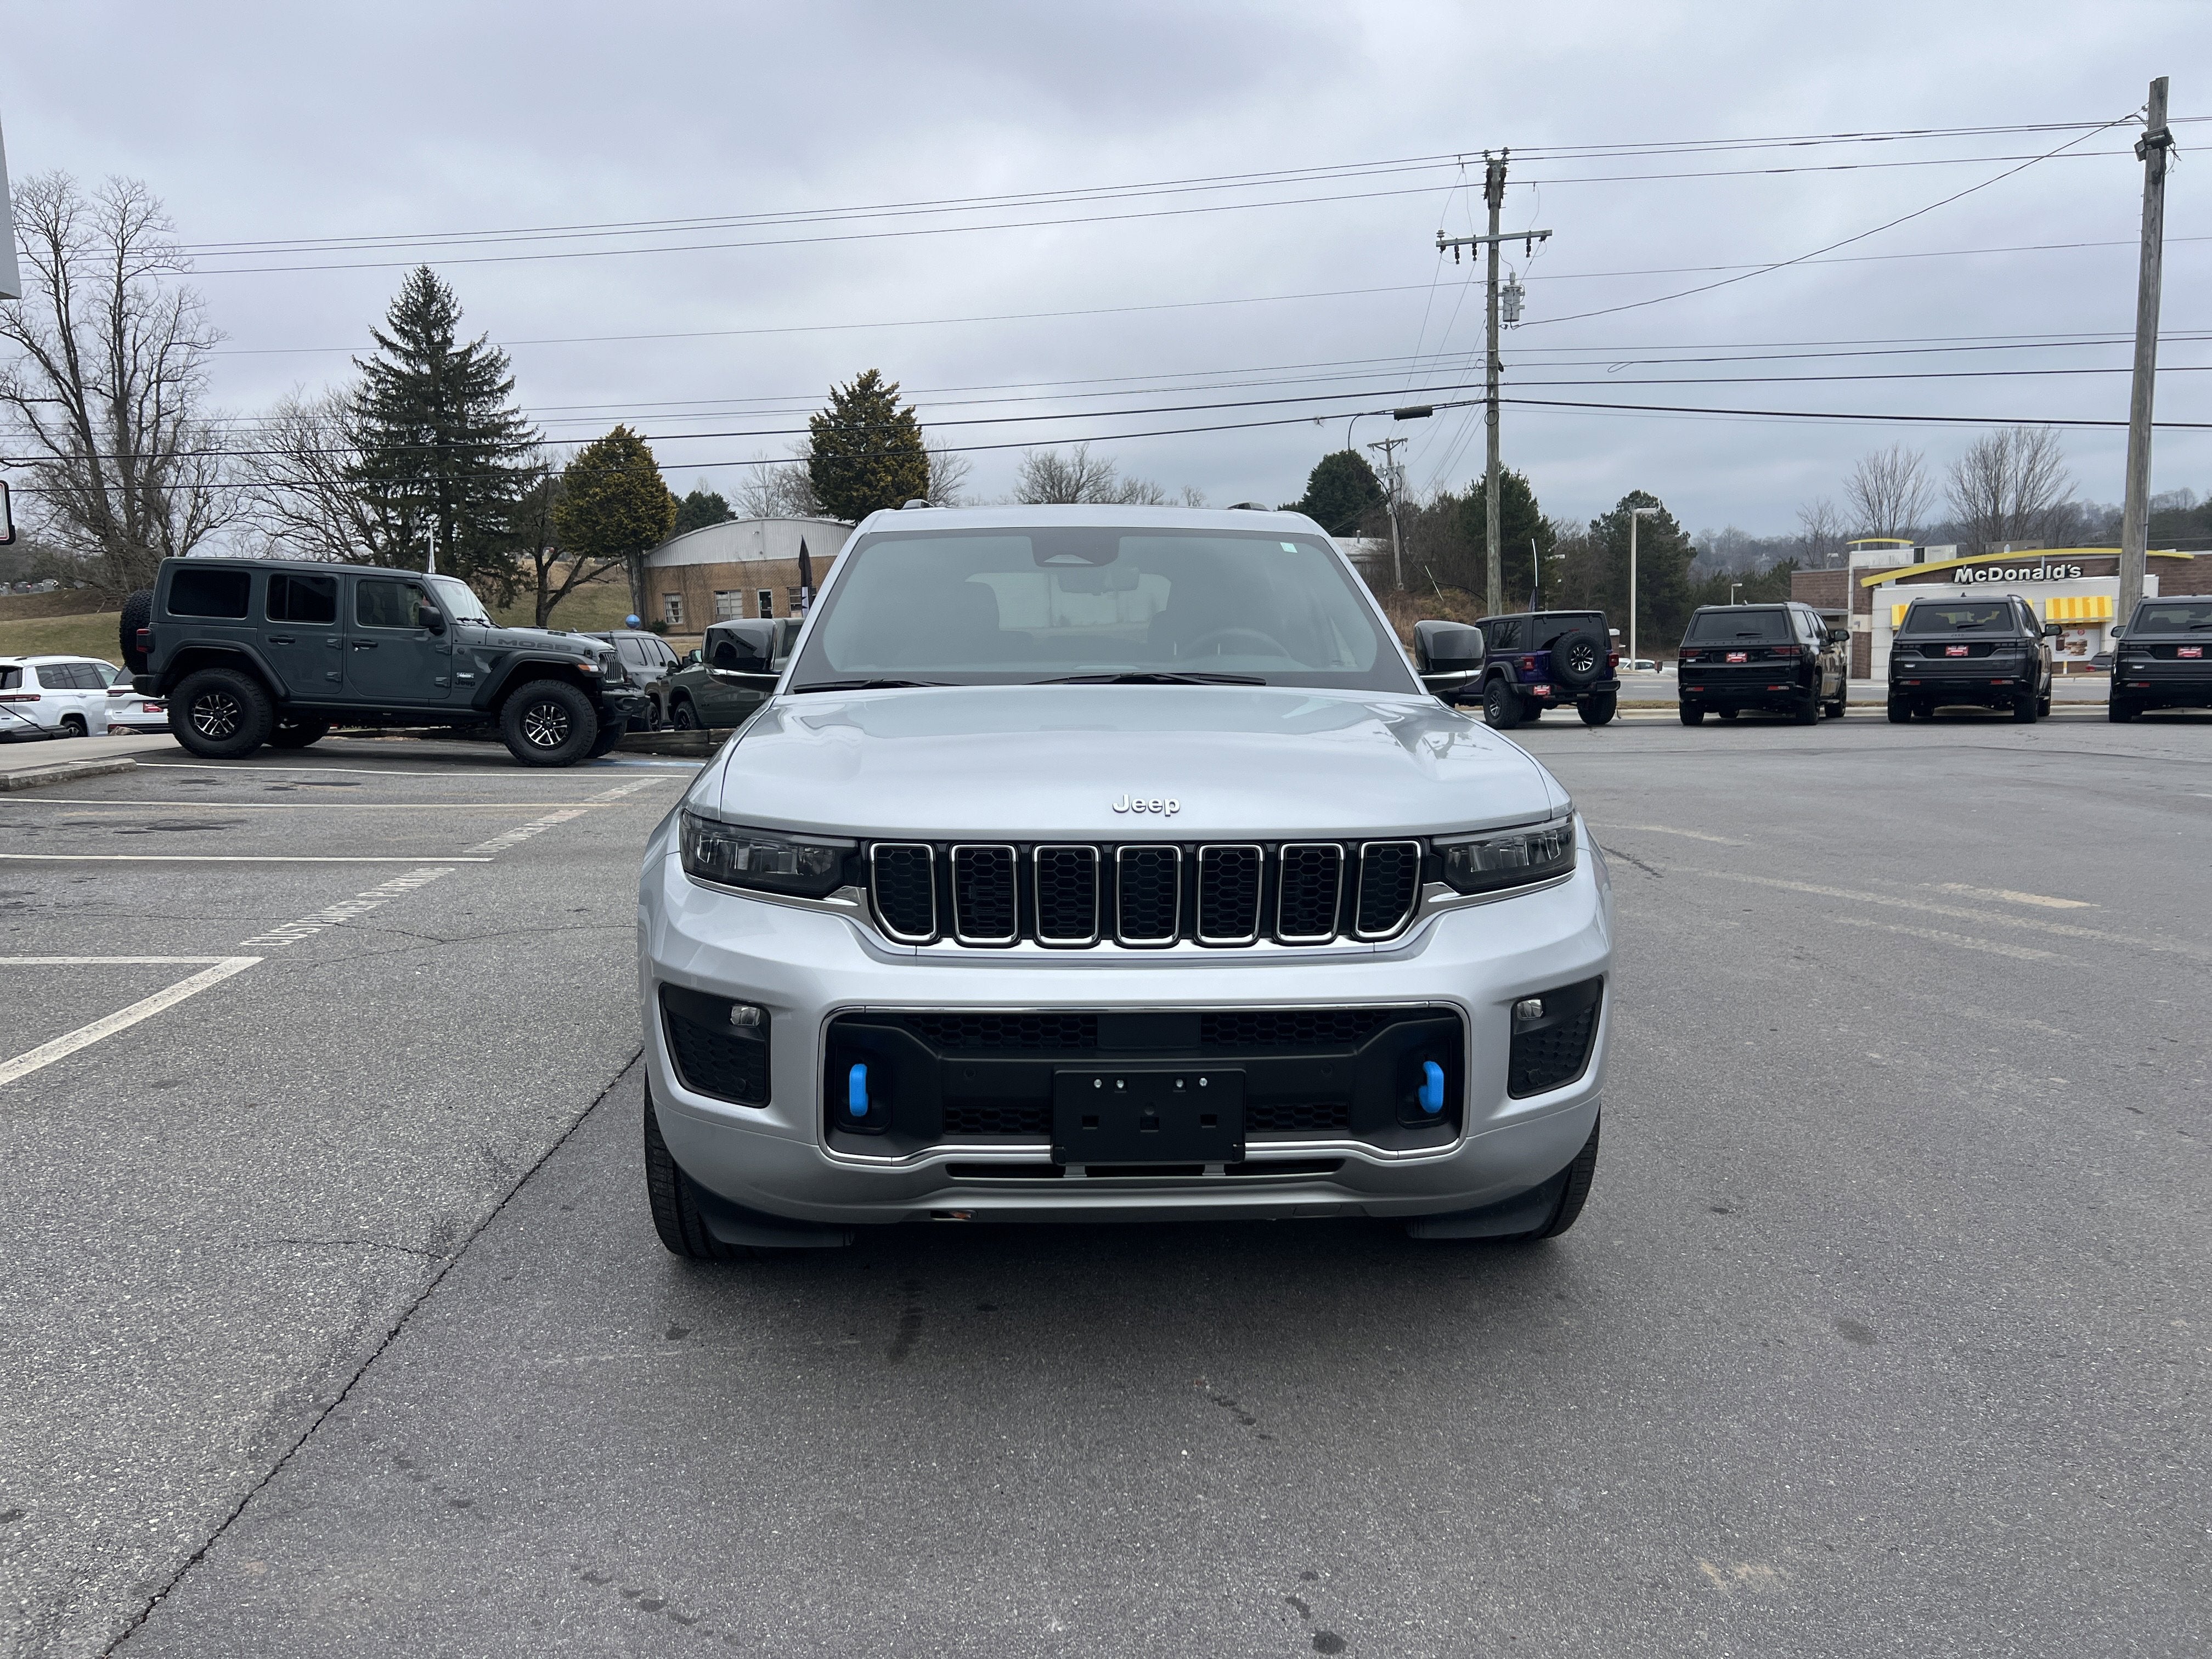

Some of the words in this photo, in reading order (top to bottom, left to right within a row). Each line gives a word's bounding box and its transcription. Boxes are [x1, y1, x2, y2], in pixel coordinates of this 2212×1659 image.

[1954, 564, 2082, 583] McDonald's
[498, 639, 572, 651] MOAB
[455, 679, 476, 687] Jeep
[1112, 794, 1181, 817] Jeep
